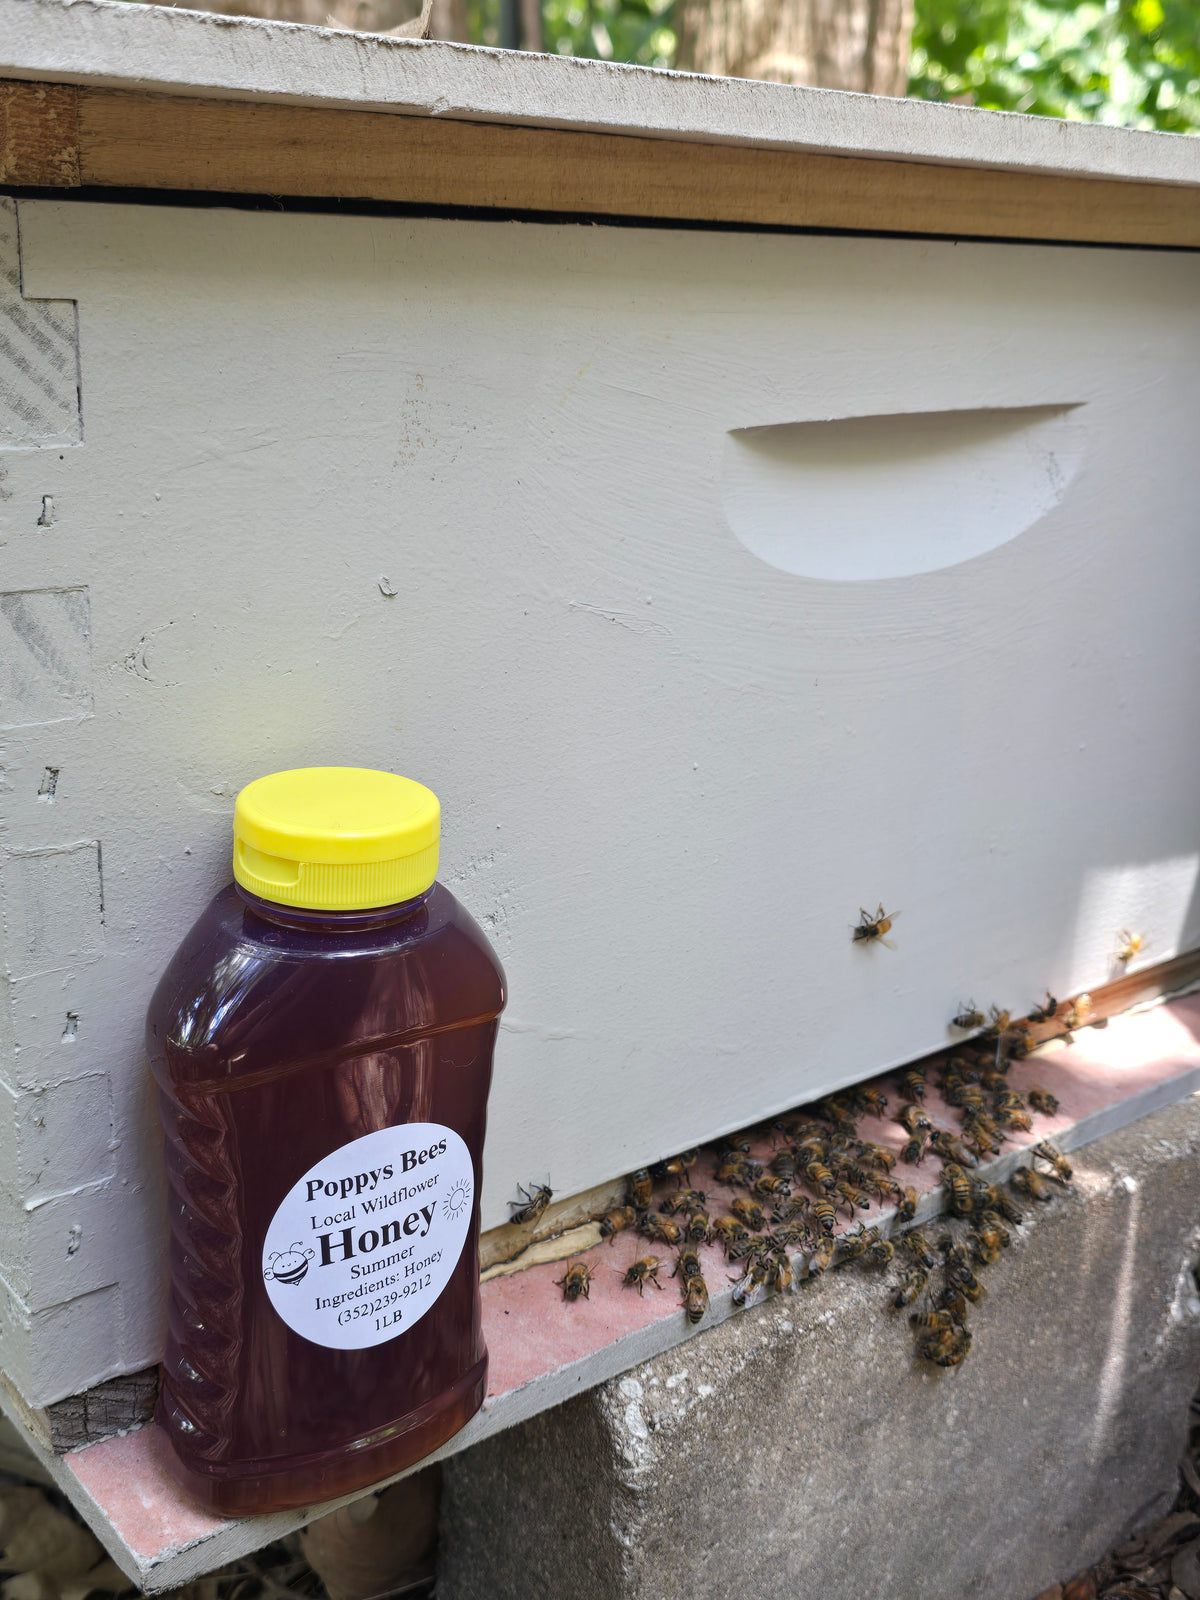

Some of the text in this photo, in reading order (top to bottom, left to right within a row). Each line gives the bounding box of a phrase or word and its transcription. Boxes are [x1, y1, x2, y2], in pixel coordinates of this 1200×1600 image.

[305, 1138, 447, 1202] Poppys Bees
[311, 1174, 440, 1230] Local Wildflower
[316, 1200, 437, 1267] Honey
[315, 1248, 444, 1311] Ingredients: Honey
[350, 1246, 415, 1280] Summer
[337, 1274, 432, 1326] (352)239-9212
[375, 1309, 403, 1331] 1LB
